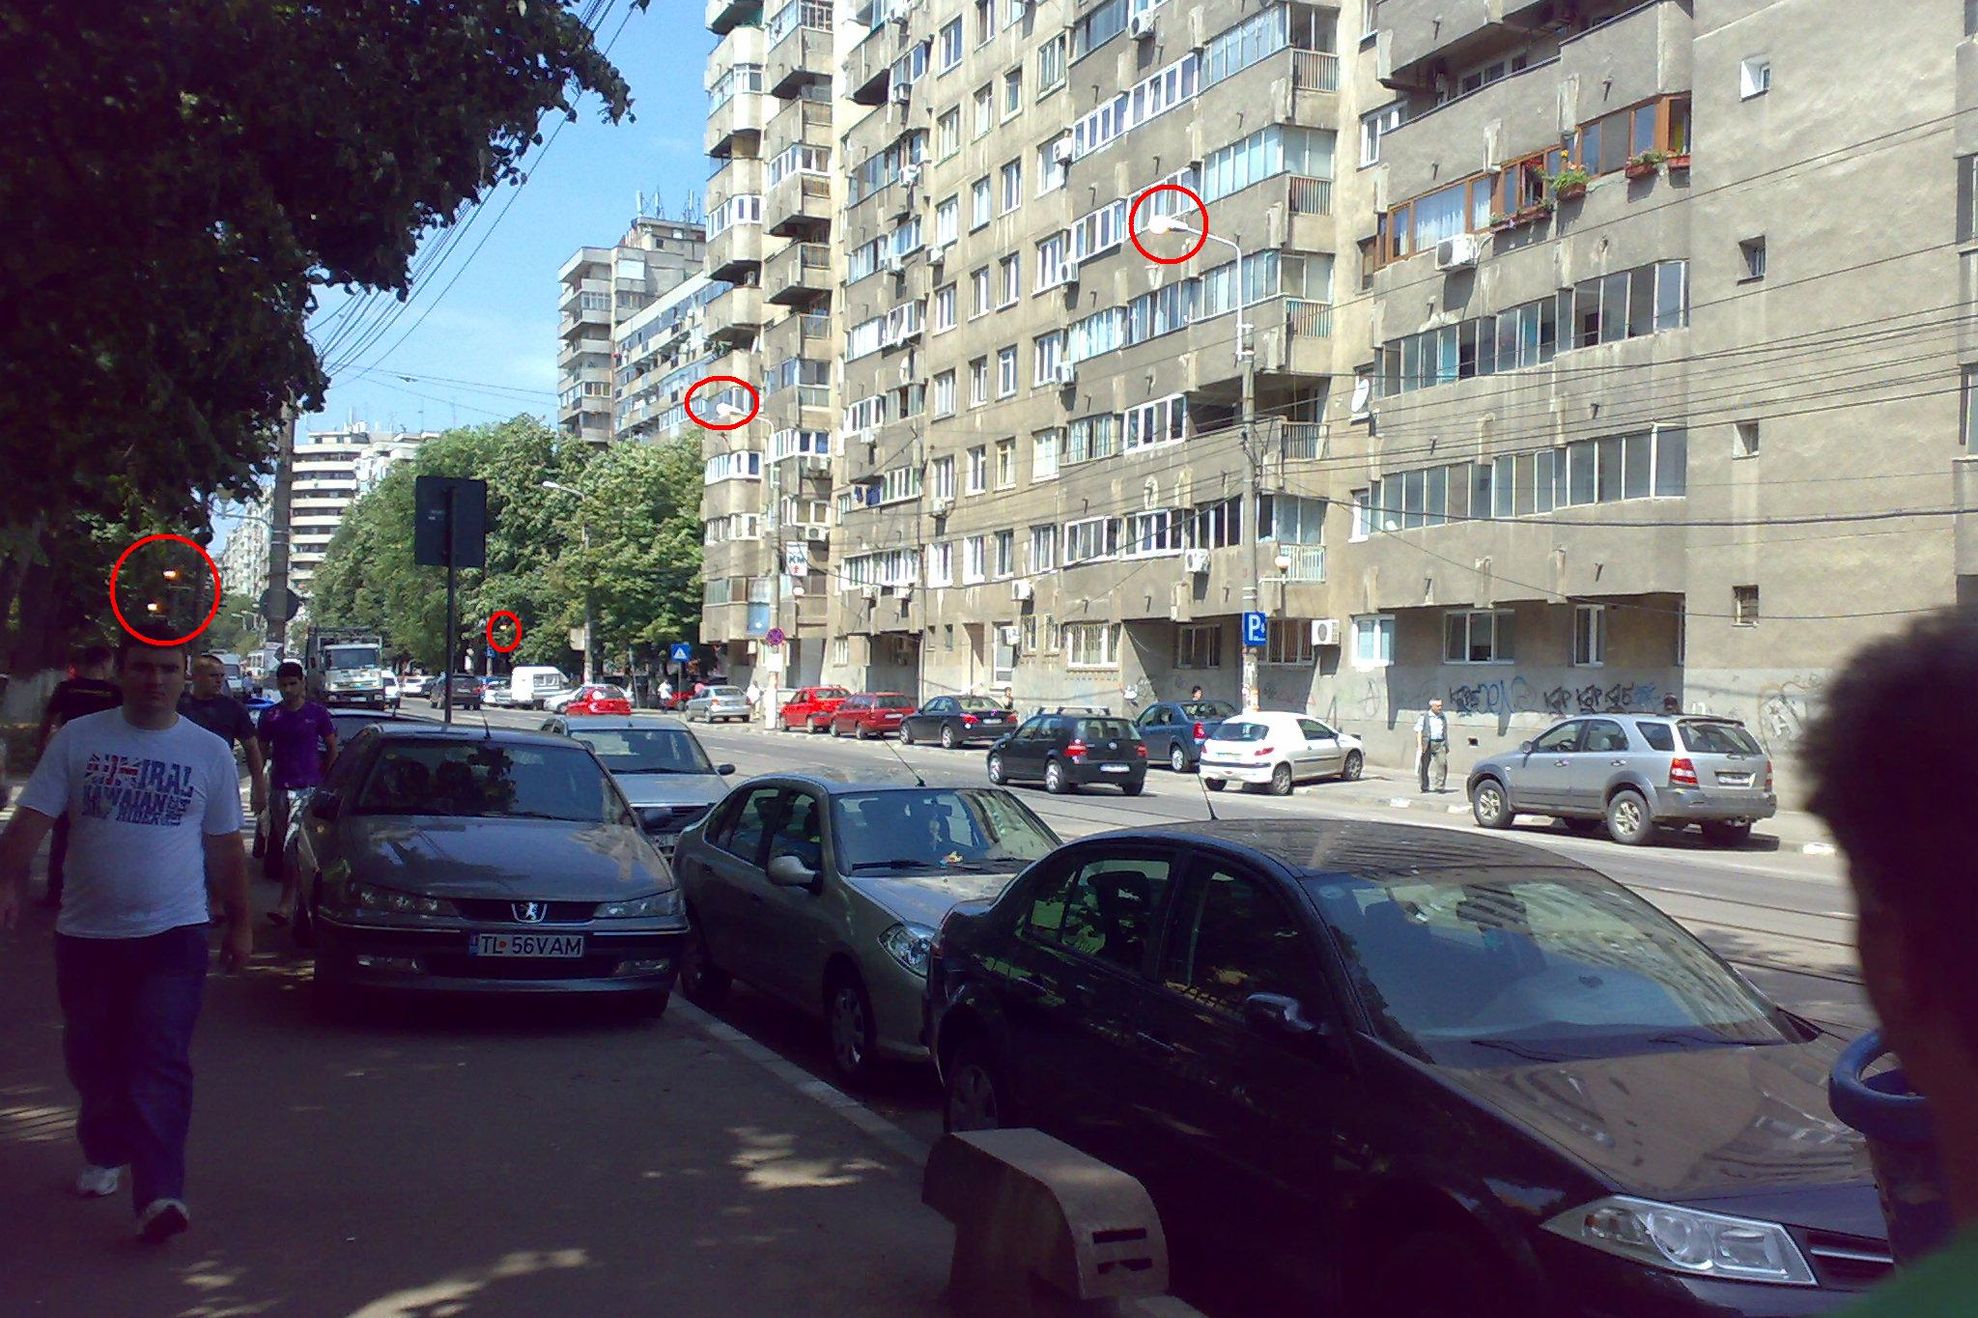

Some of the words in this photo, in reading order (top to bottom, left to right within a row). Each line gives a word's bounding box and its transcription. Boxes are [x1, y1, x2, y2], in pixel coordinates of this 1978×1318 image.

[1248, 614, 1261, 642] P
[481, 936, 503, 954] TL
[512, 936, 581, 955] 56VAM
